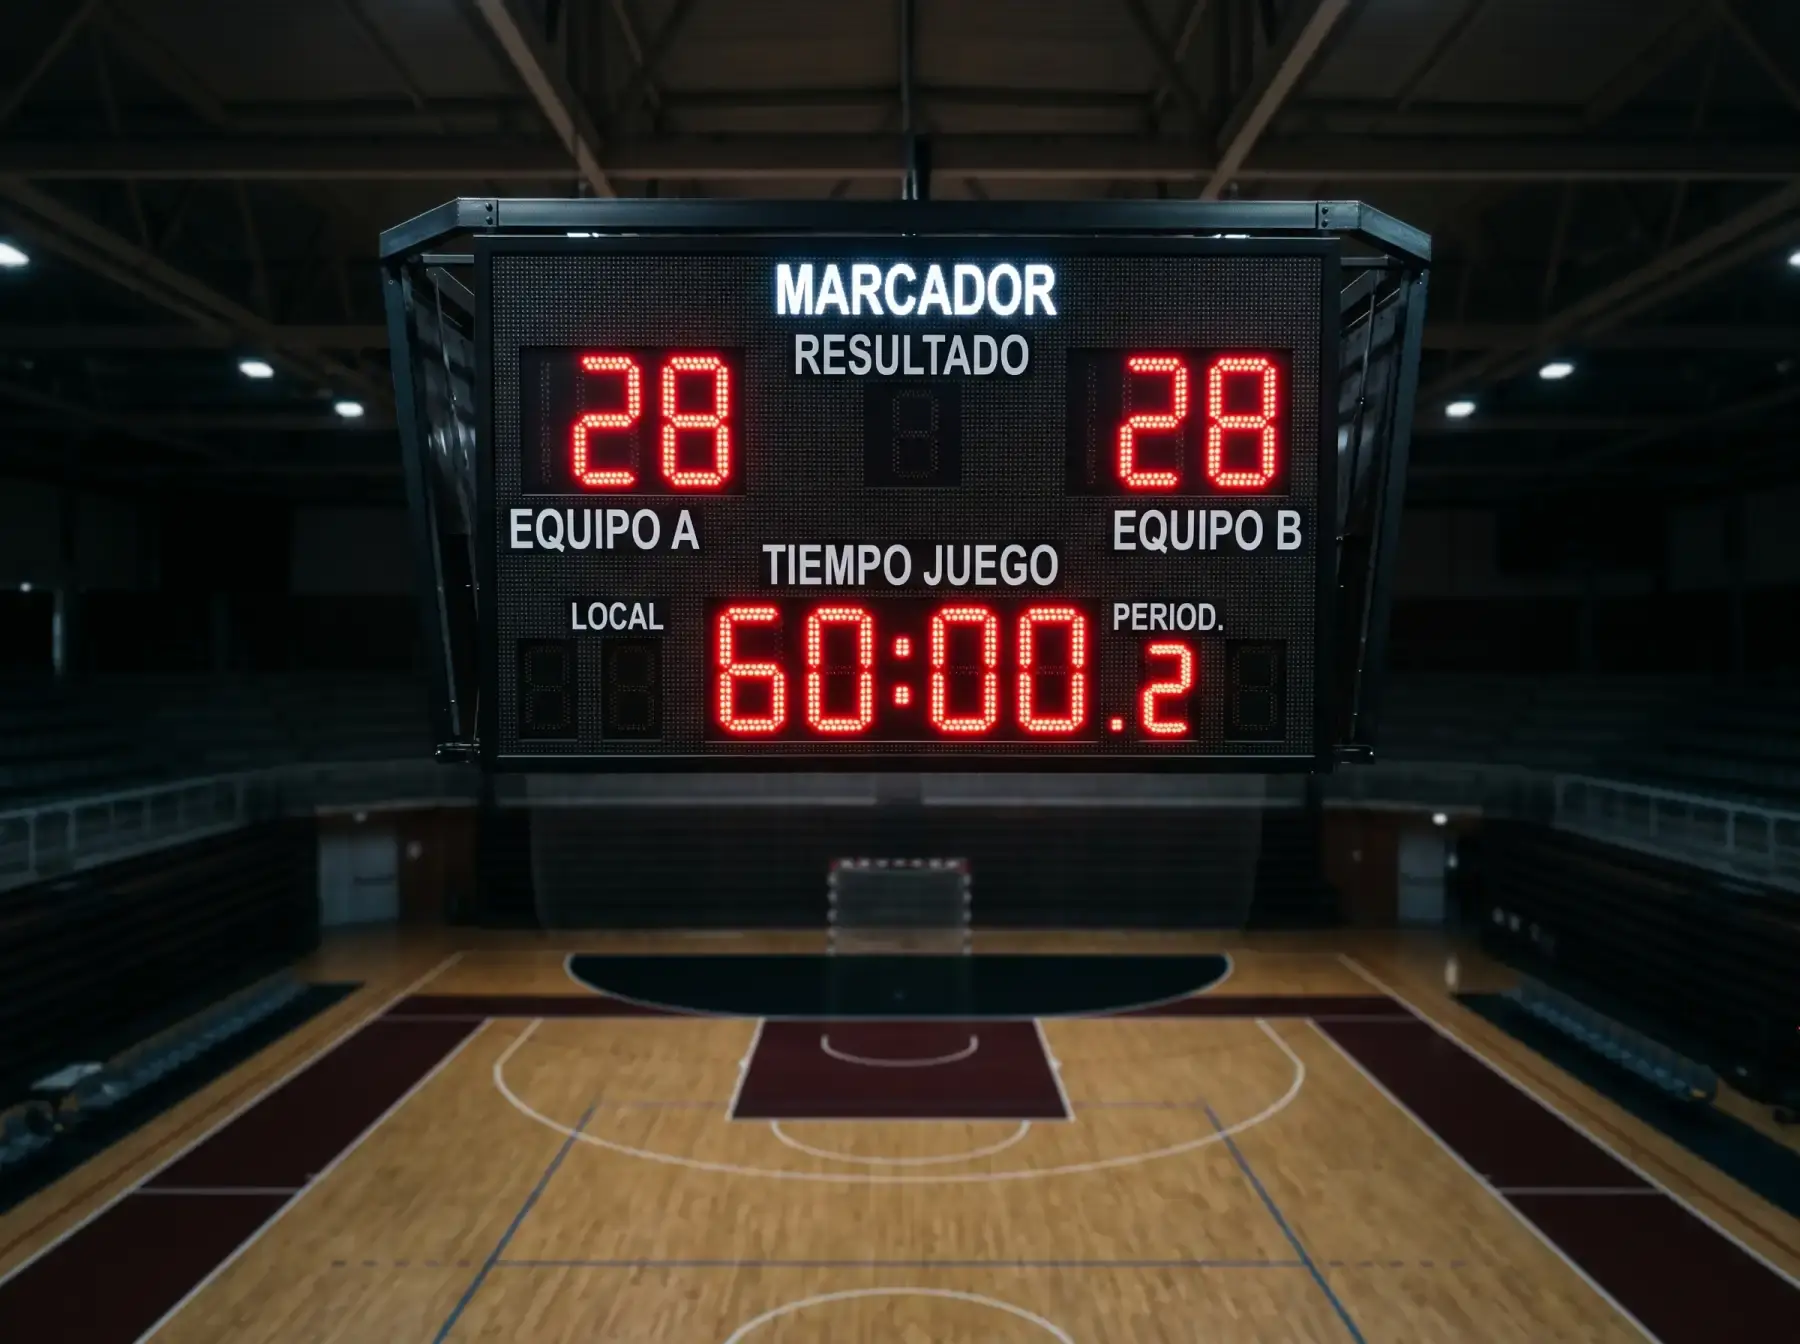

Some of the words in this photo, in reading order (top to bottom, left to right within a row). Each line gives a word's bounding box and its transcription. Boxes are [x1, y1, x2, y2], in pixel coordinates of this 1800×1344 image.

[777, 263, 1057, 316] MARCADOR
[795, 334, 1029, 376] RESULTADO
[573, 356, 730, 487] 28
[1119, 357, 1277, 488] 28
[510, 508, 661, 553] EQUIPO
[671, 509, 700, 550] A
[1113, 509, 1264, 554] EQUIPO
[1278, 510, 1302, 551] B
[762, 544, 912, 586] TIEMPO
[924, 544, 1059, 586] JUEGO
[571, 602, 664, 631] LOCAL
[1113, 602, 1224, 631] PERIOD.
